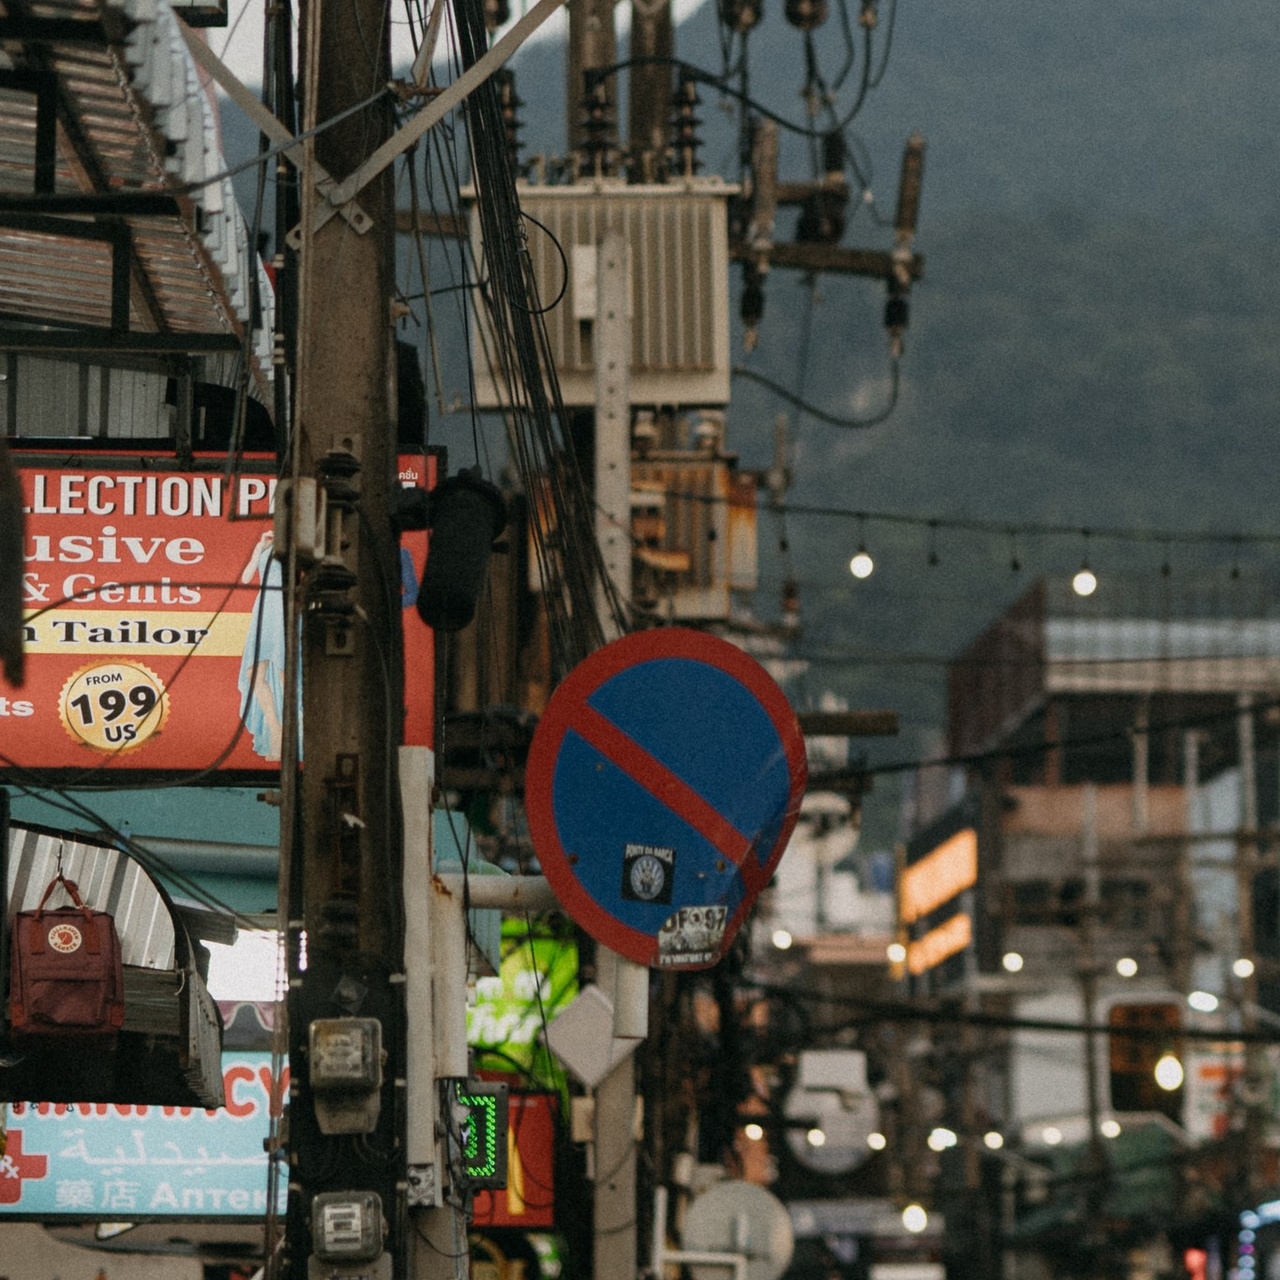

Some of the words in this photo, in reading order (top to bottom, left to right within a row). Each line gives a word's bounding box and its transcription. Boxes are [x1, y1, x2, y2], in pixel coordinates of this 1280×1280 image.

[62, 573, 201, 605] Gents
[52, 620, 208, 645] Tailor
[86, 672, 123, 686] FROM
[71, 685, 156, 725] 199
[105, 723, 137, 742] US
